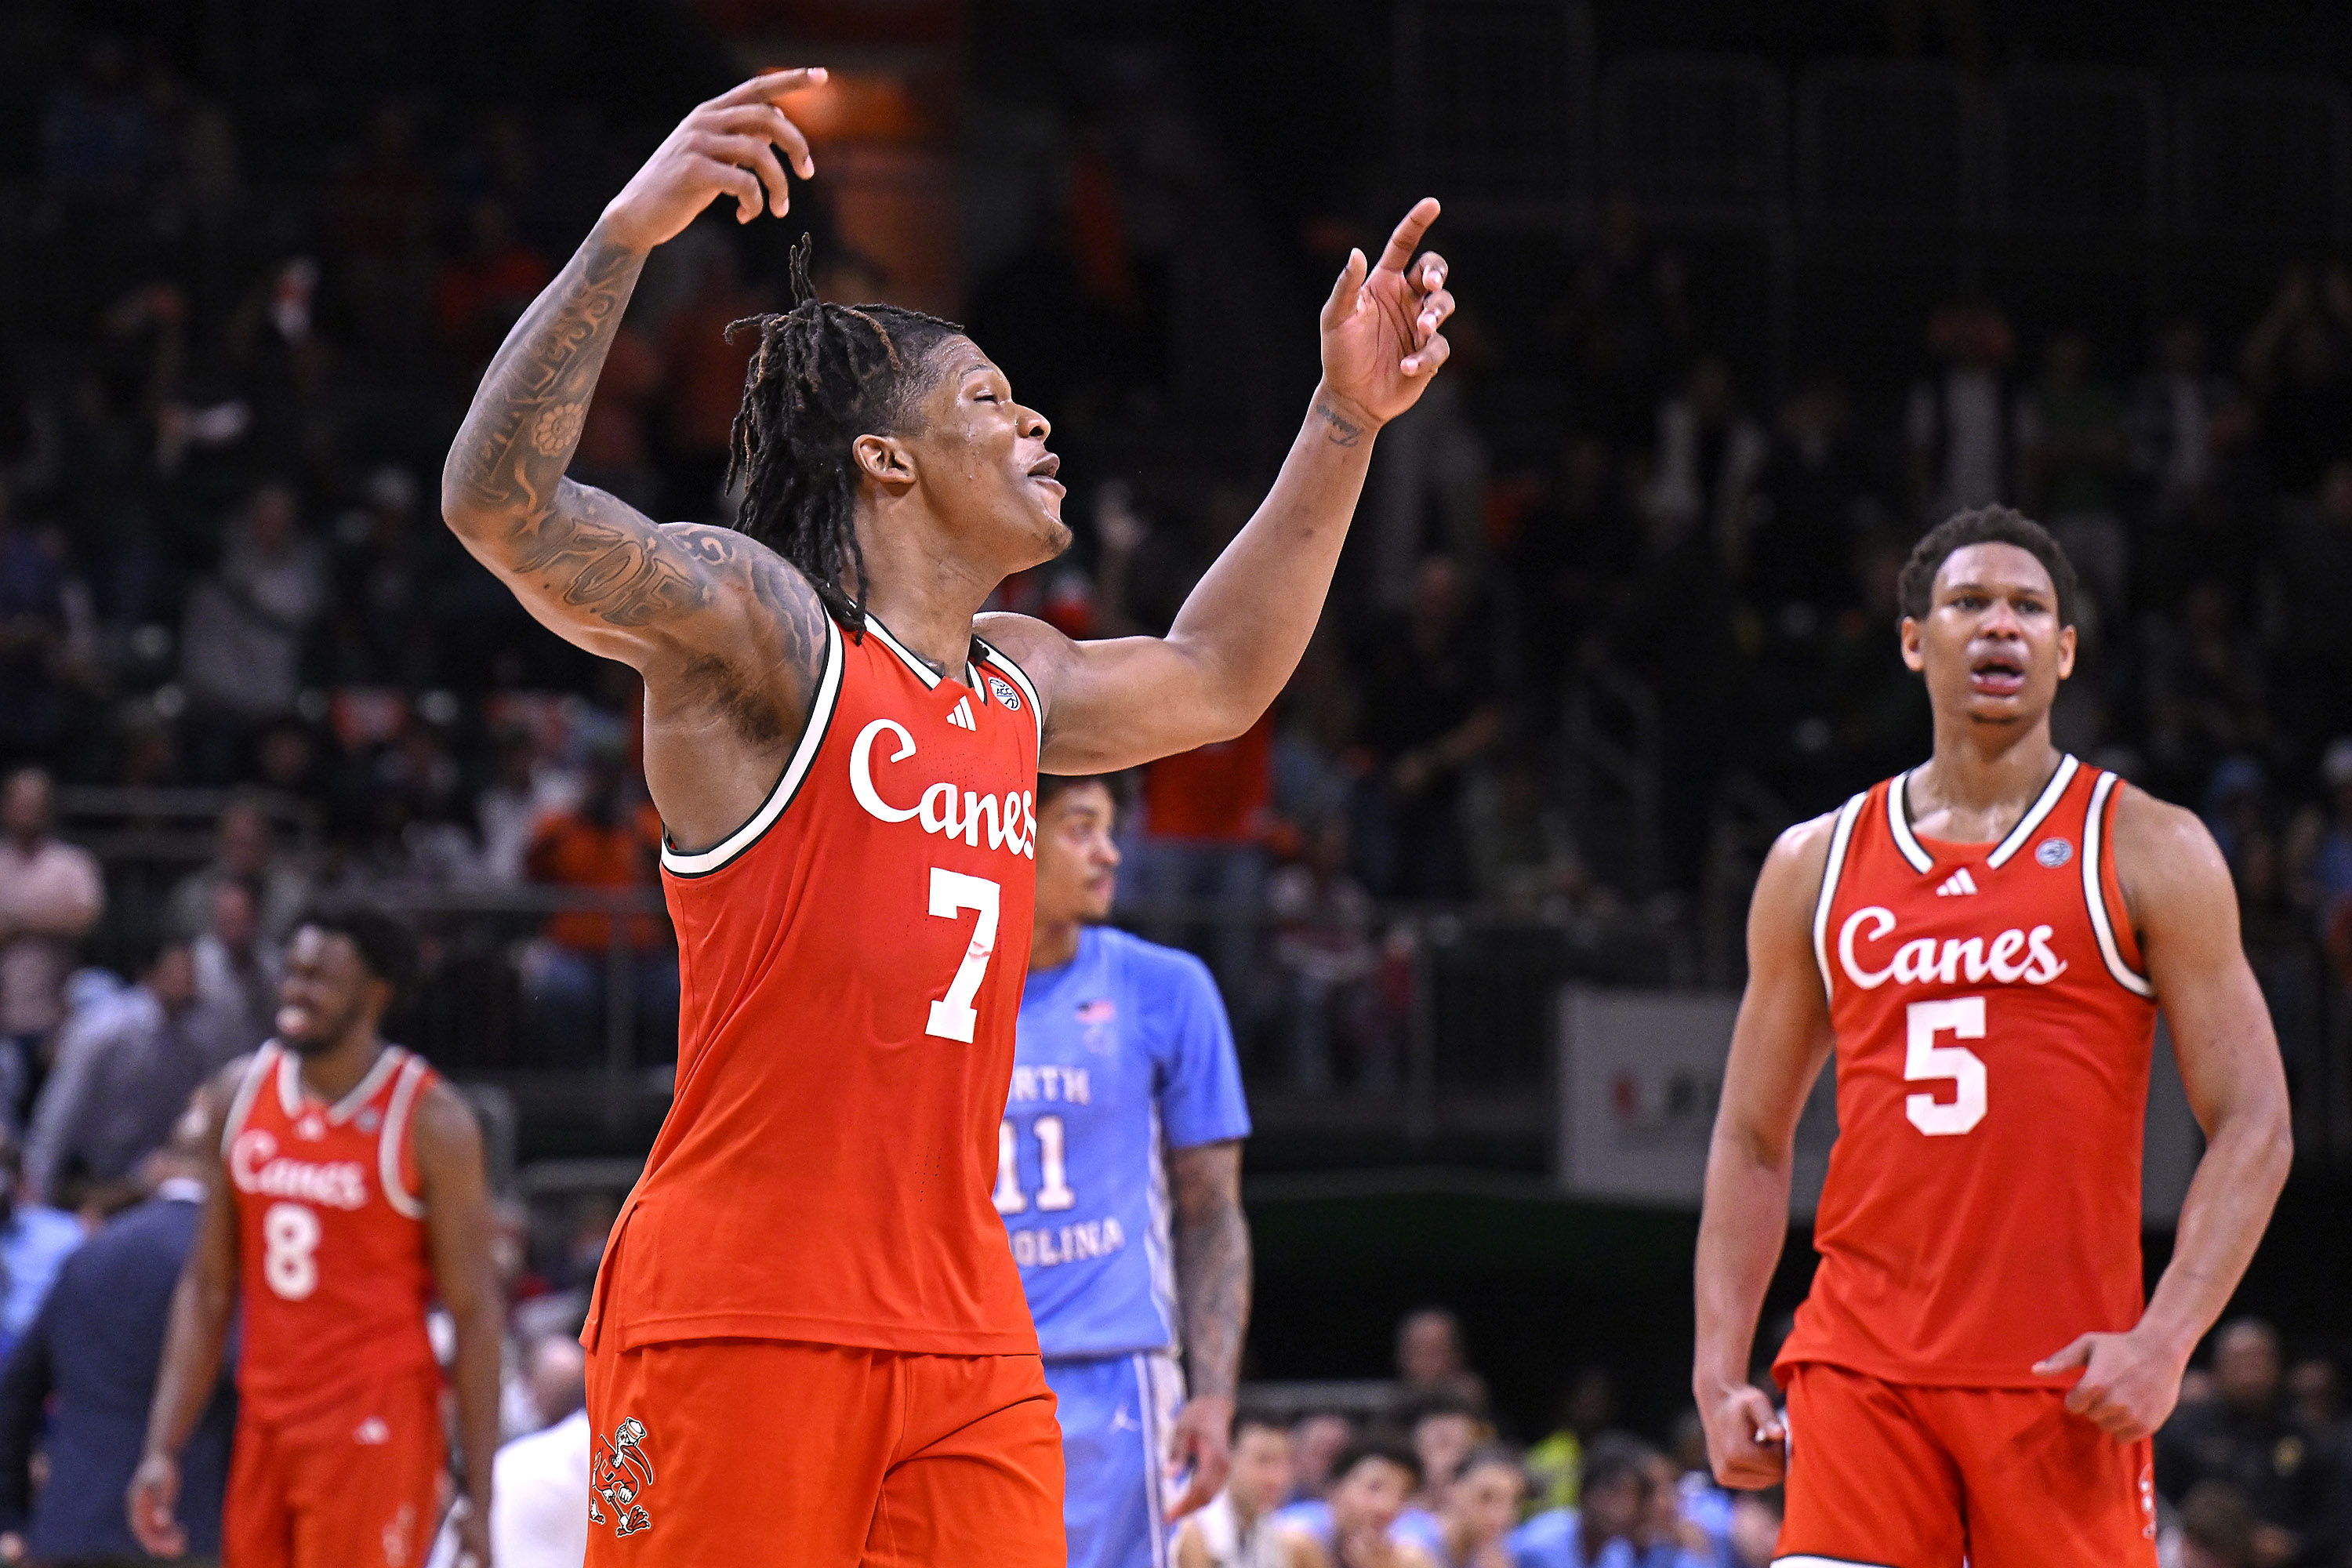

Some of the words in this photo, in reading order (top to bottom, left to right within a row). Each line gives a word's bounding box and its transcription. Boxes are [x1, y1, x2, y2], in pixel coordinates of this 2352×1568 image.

[849, 718, 1036, 860] Canes
[924, 867, 1000, 1044] 7
[1838, 906, 2069, 990] Canes
[1011, 1064, 1091, 1107] RTH
[1904, 996, 1987, 1137] 5
[231, 1129, 368, 1210] Canes
[991, 1116, 1076, 1214] 11
[263, 1202, 322, 1301] 8
[1010, 1216, 1126, 1268] OLINA
